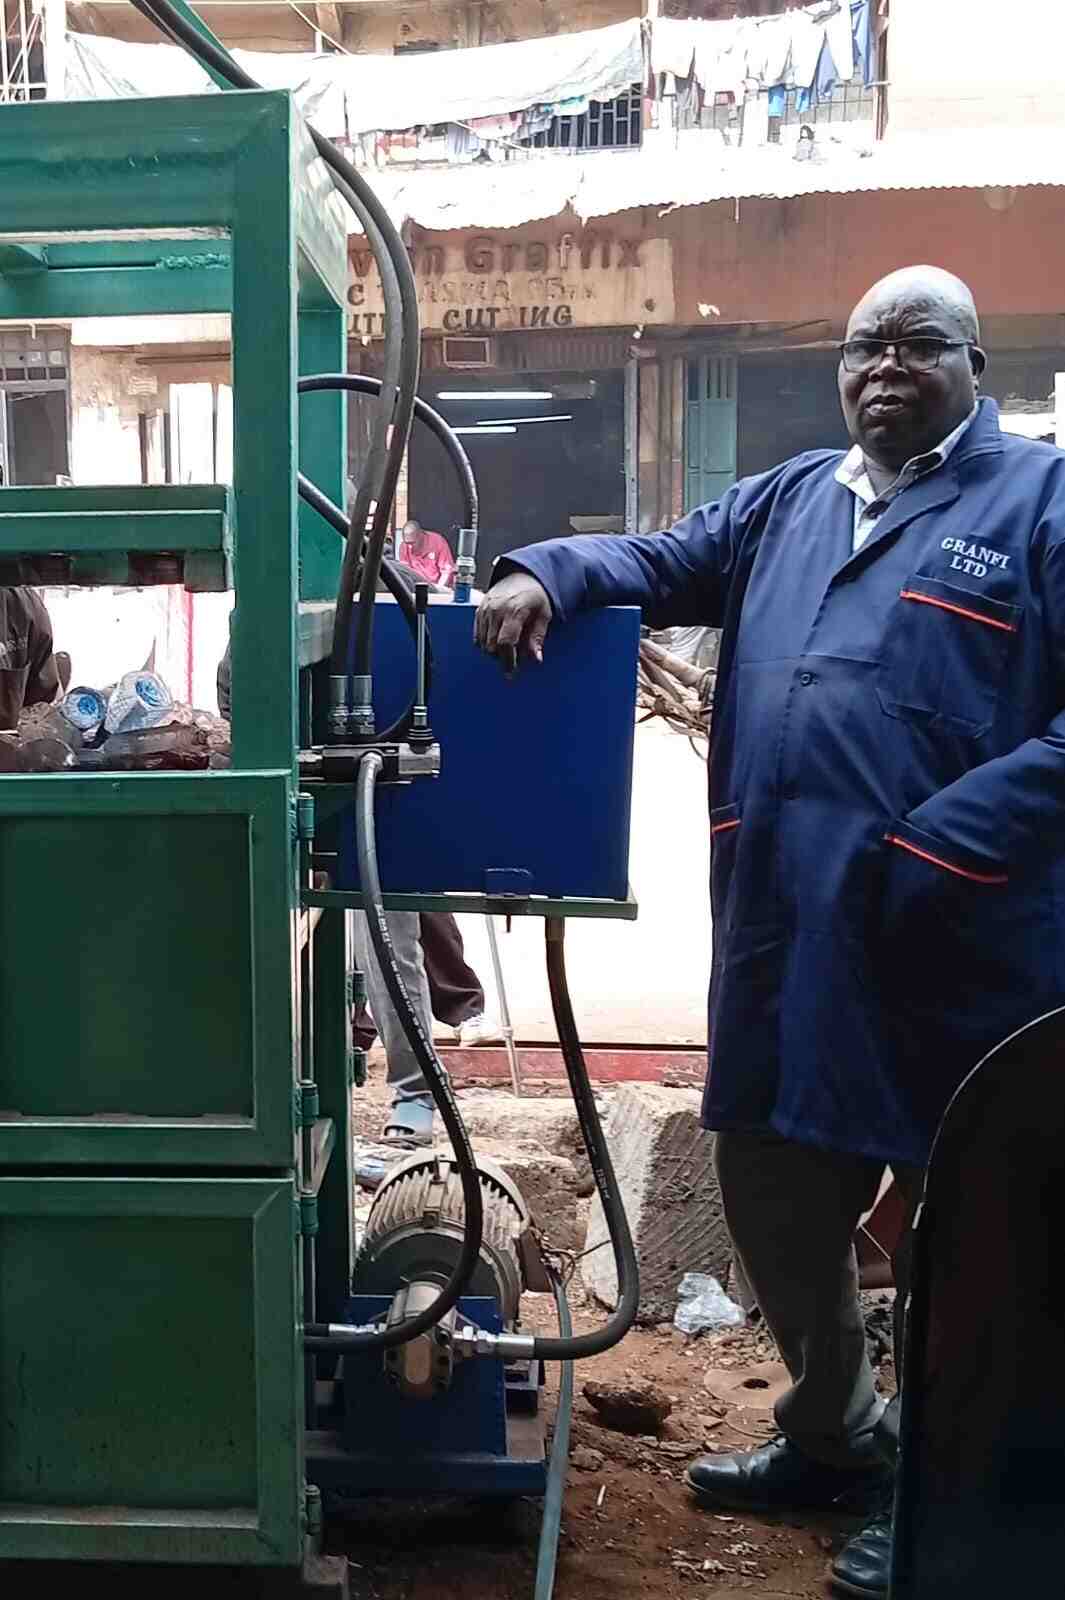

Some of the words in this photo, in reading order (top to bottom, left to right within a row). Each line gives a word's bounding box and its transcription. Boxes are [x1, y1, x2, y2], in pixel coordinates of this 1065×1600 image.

[443, 305, 572, 331] CUTING
[941, 537, 1011, 569] GRANFI
[950, 556, 987, 578] LTD
